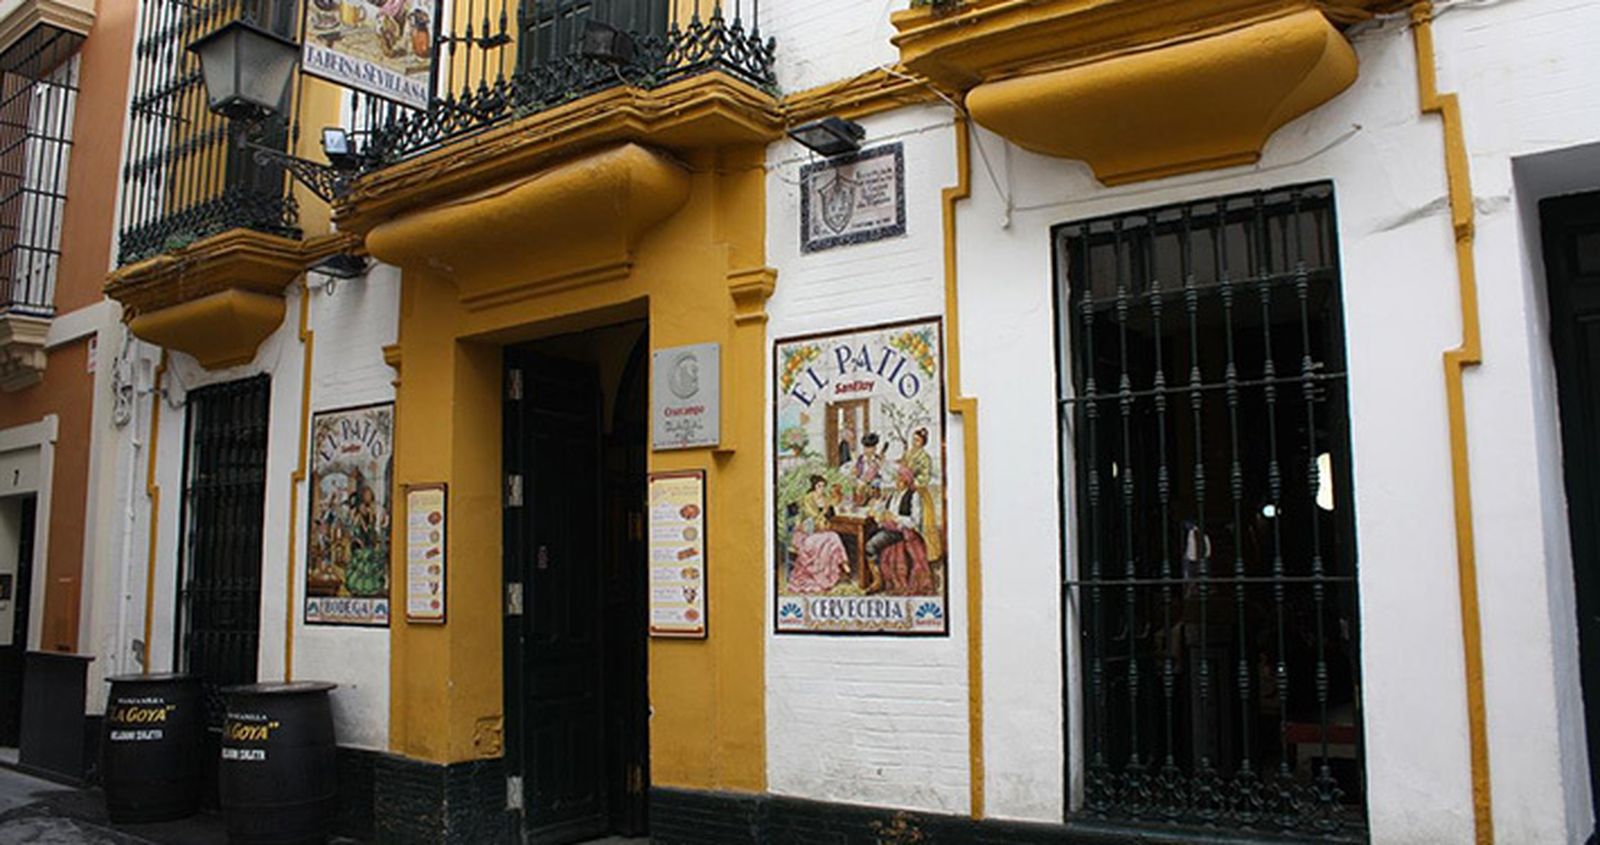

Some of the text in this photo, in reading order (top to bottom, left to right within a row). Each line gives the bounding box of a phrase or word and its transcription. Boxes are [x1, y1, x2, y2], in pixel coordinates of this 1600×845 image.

[306, 45, 427, 102] TABERNA SEVILLANA
[791, 344, 920, 408] EL PATIO
[319, 418, 383, 461] EL PATIO
[324, 599, 369, 614] BODEGA
[811, 598, 903, 620] CERVECERIA
